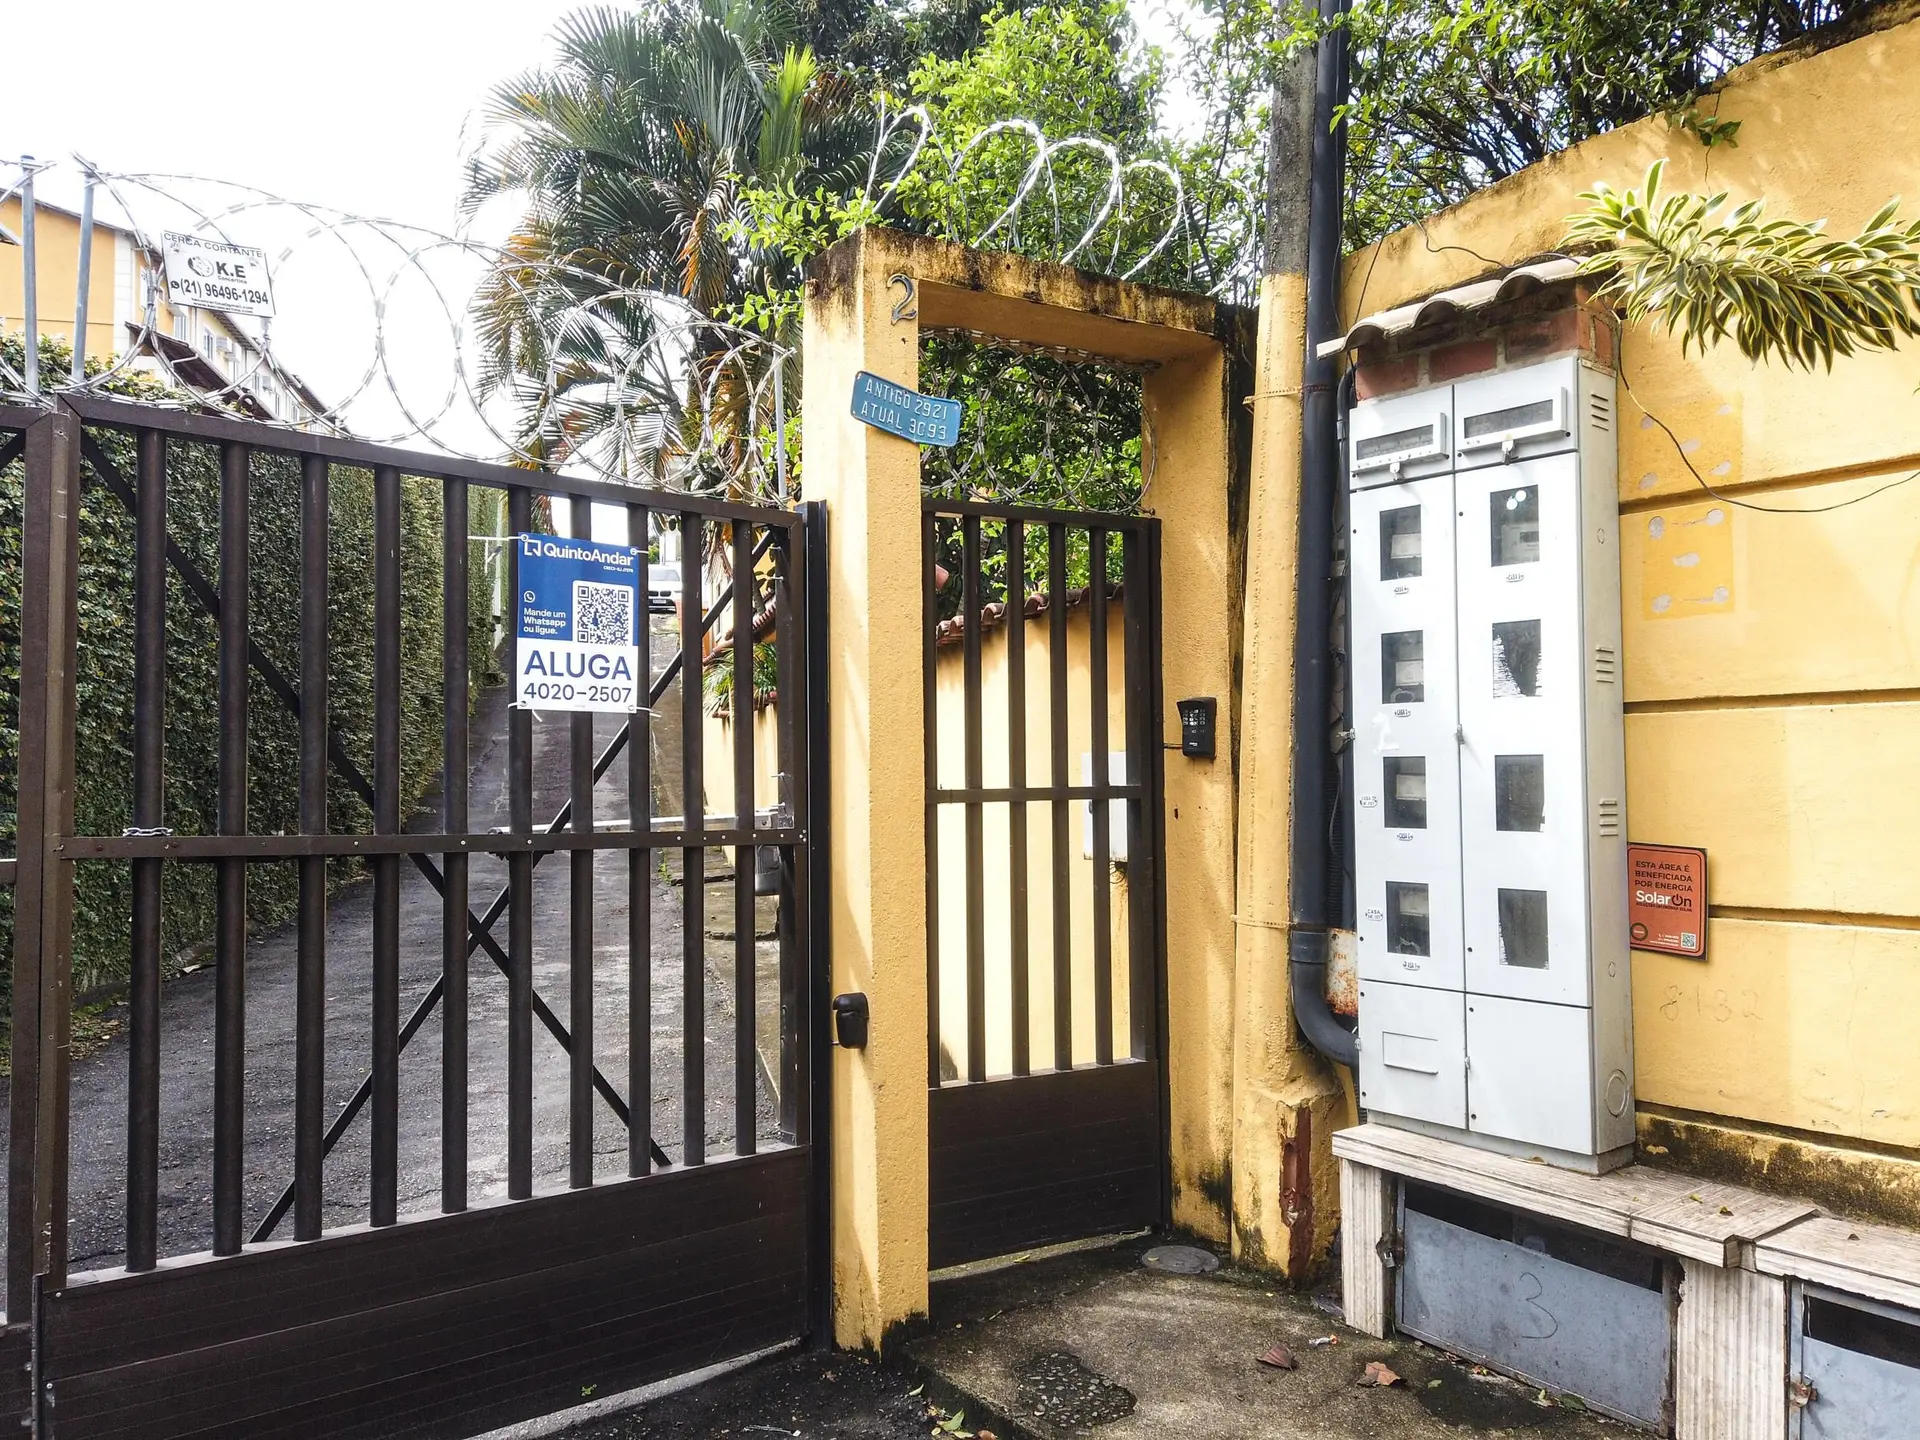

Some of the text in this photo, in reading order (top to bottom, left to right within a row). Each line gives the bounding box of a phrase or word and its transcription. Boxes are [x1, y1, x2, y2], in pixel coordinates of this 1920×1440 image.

[164, 232, 263, 258] CERCA CORTANTE
[215, 261, 247, 279] K.E
[180, 278, 202, 299] (21)
[204, 283, 269, 305] 96496-1294
[886, 273, 917, 326] 2
[865, 378, 947, 420] ANTIGO 2921
[861, 401, 903, 430] ATUAL
[543, 542, 634, 566] QuintoAndar
[523, 616, 567, 628] Whatsapp
[524, 607, 552, 617] Mande
[523, 626, 558, 635] ou ligue.
[523, 649, 632, 681] ALUGA
[523, 682, 632, 703] 4020-2507
[1635, 870, 1693, 883] BENEFICIADA
[1636, 860, 1690, 873] ESTA ÁREA É
[1635, 880, 1693, 893] POR ENERGIA
[1520, 1271, 1558, 1339] 3
